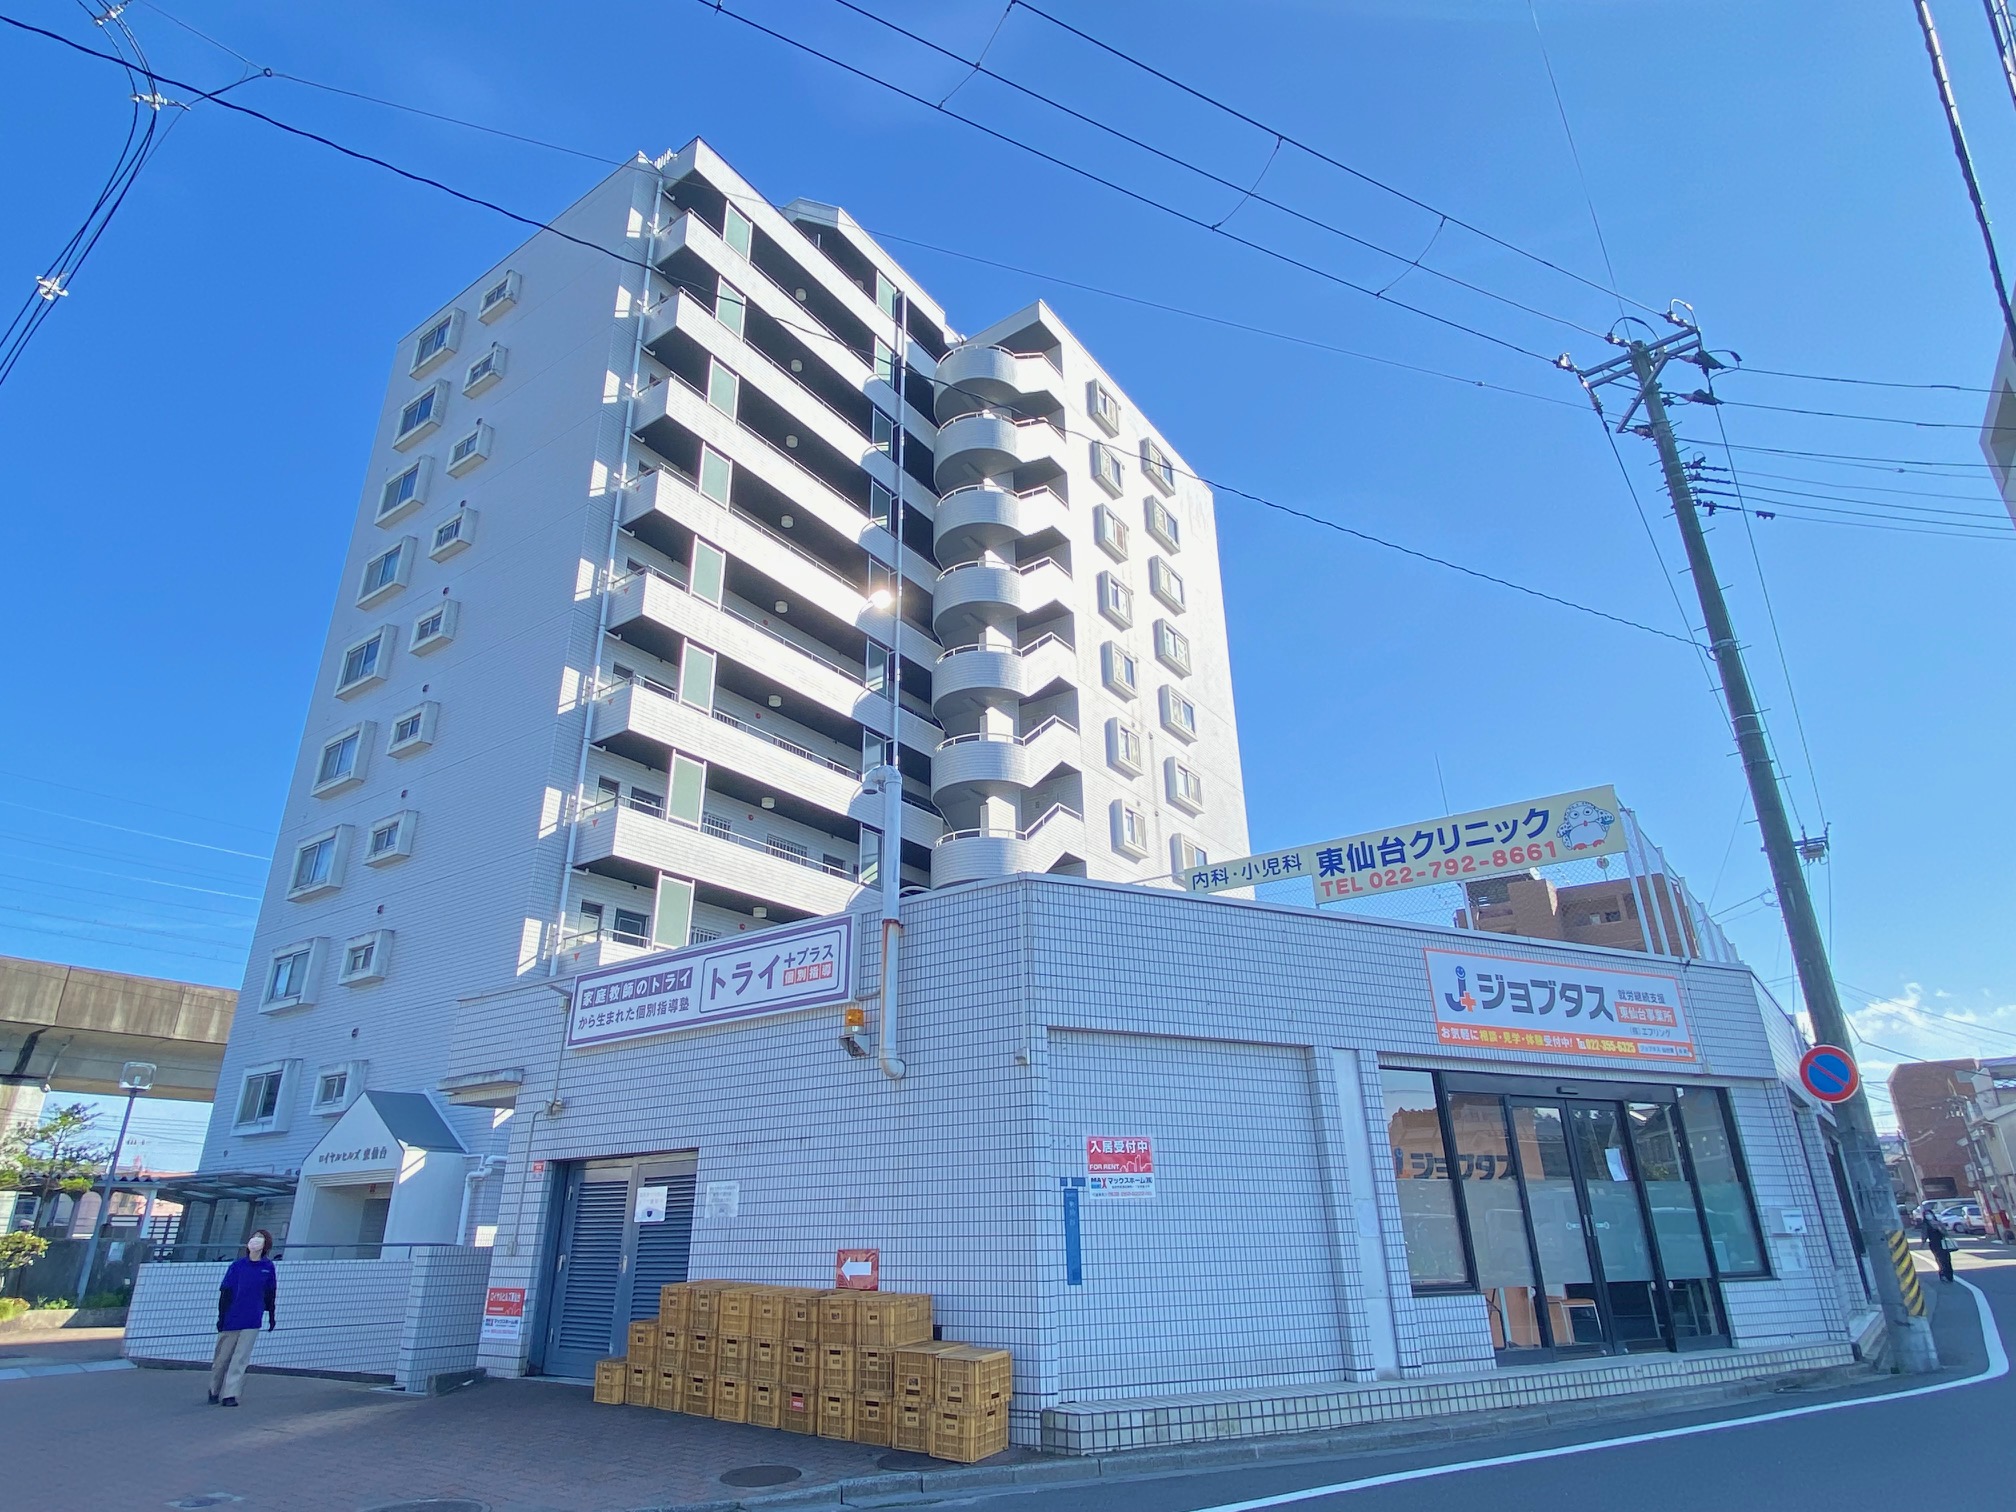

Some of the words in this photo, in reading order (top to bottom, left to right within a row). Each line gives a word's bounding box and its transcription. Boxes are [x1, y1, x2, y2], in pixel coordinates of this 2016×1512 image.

[1315, 807, 1550, 878] 東仙台クリニック
[1191, 853, 1302, 891] 内科・小児科
[1321, 876, 1363, 898] TEL
[1369, 841, 1557, 889] 022-792-8661
[582, 969, 691, 1007] 家庭教師のトライ
[709, 955, 780, 1000] トライ
[784, 963, 832, 985] 個別指導
[577, 996, 690, 1030] から生まれた個別指導塾
[1476, 973, 1615, 1022] ジョブタス
[1618, 1006, 1673, 1024] 東仙台事業所
[1090, 1140, 1149, 1154] 入居受付中
